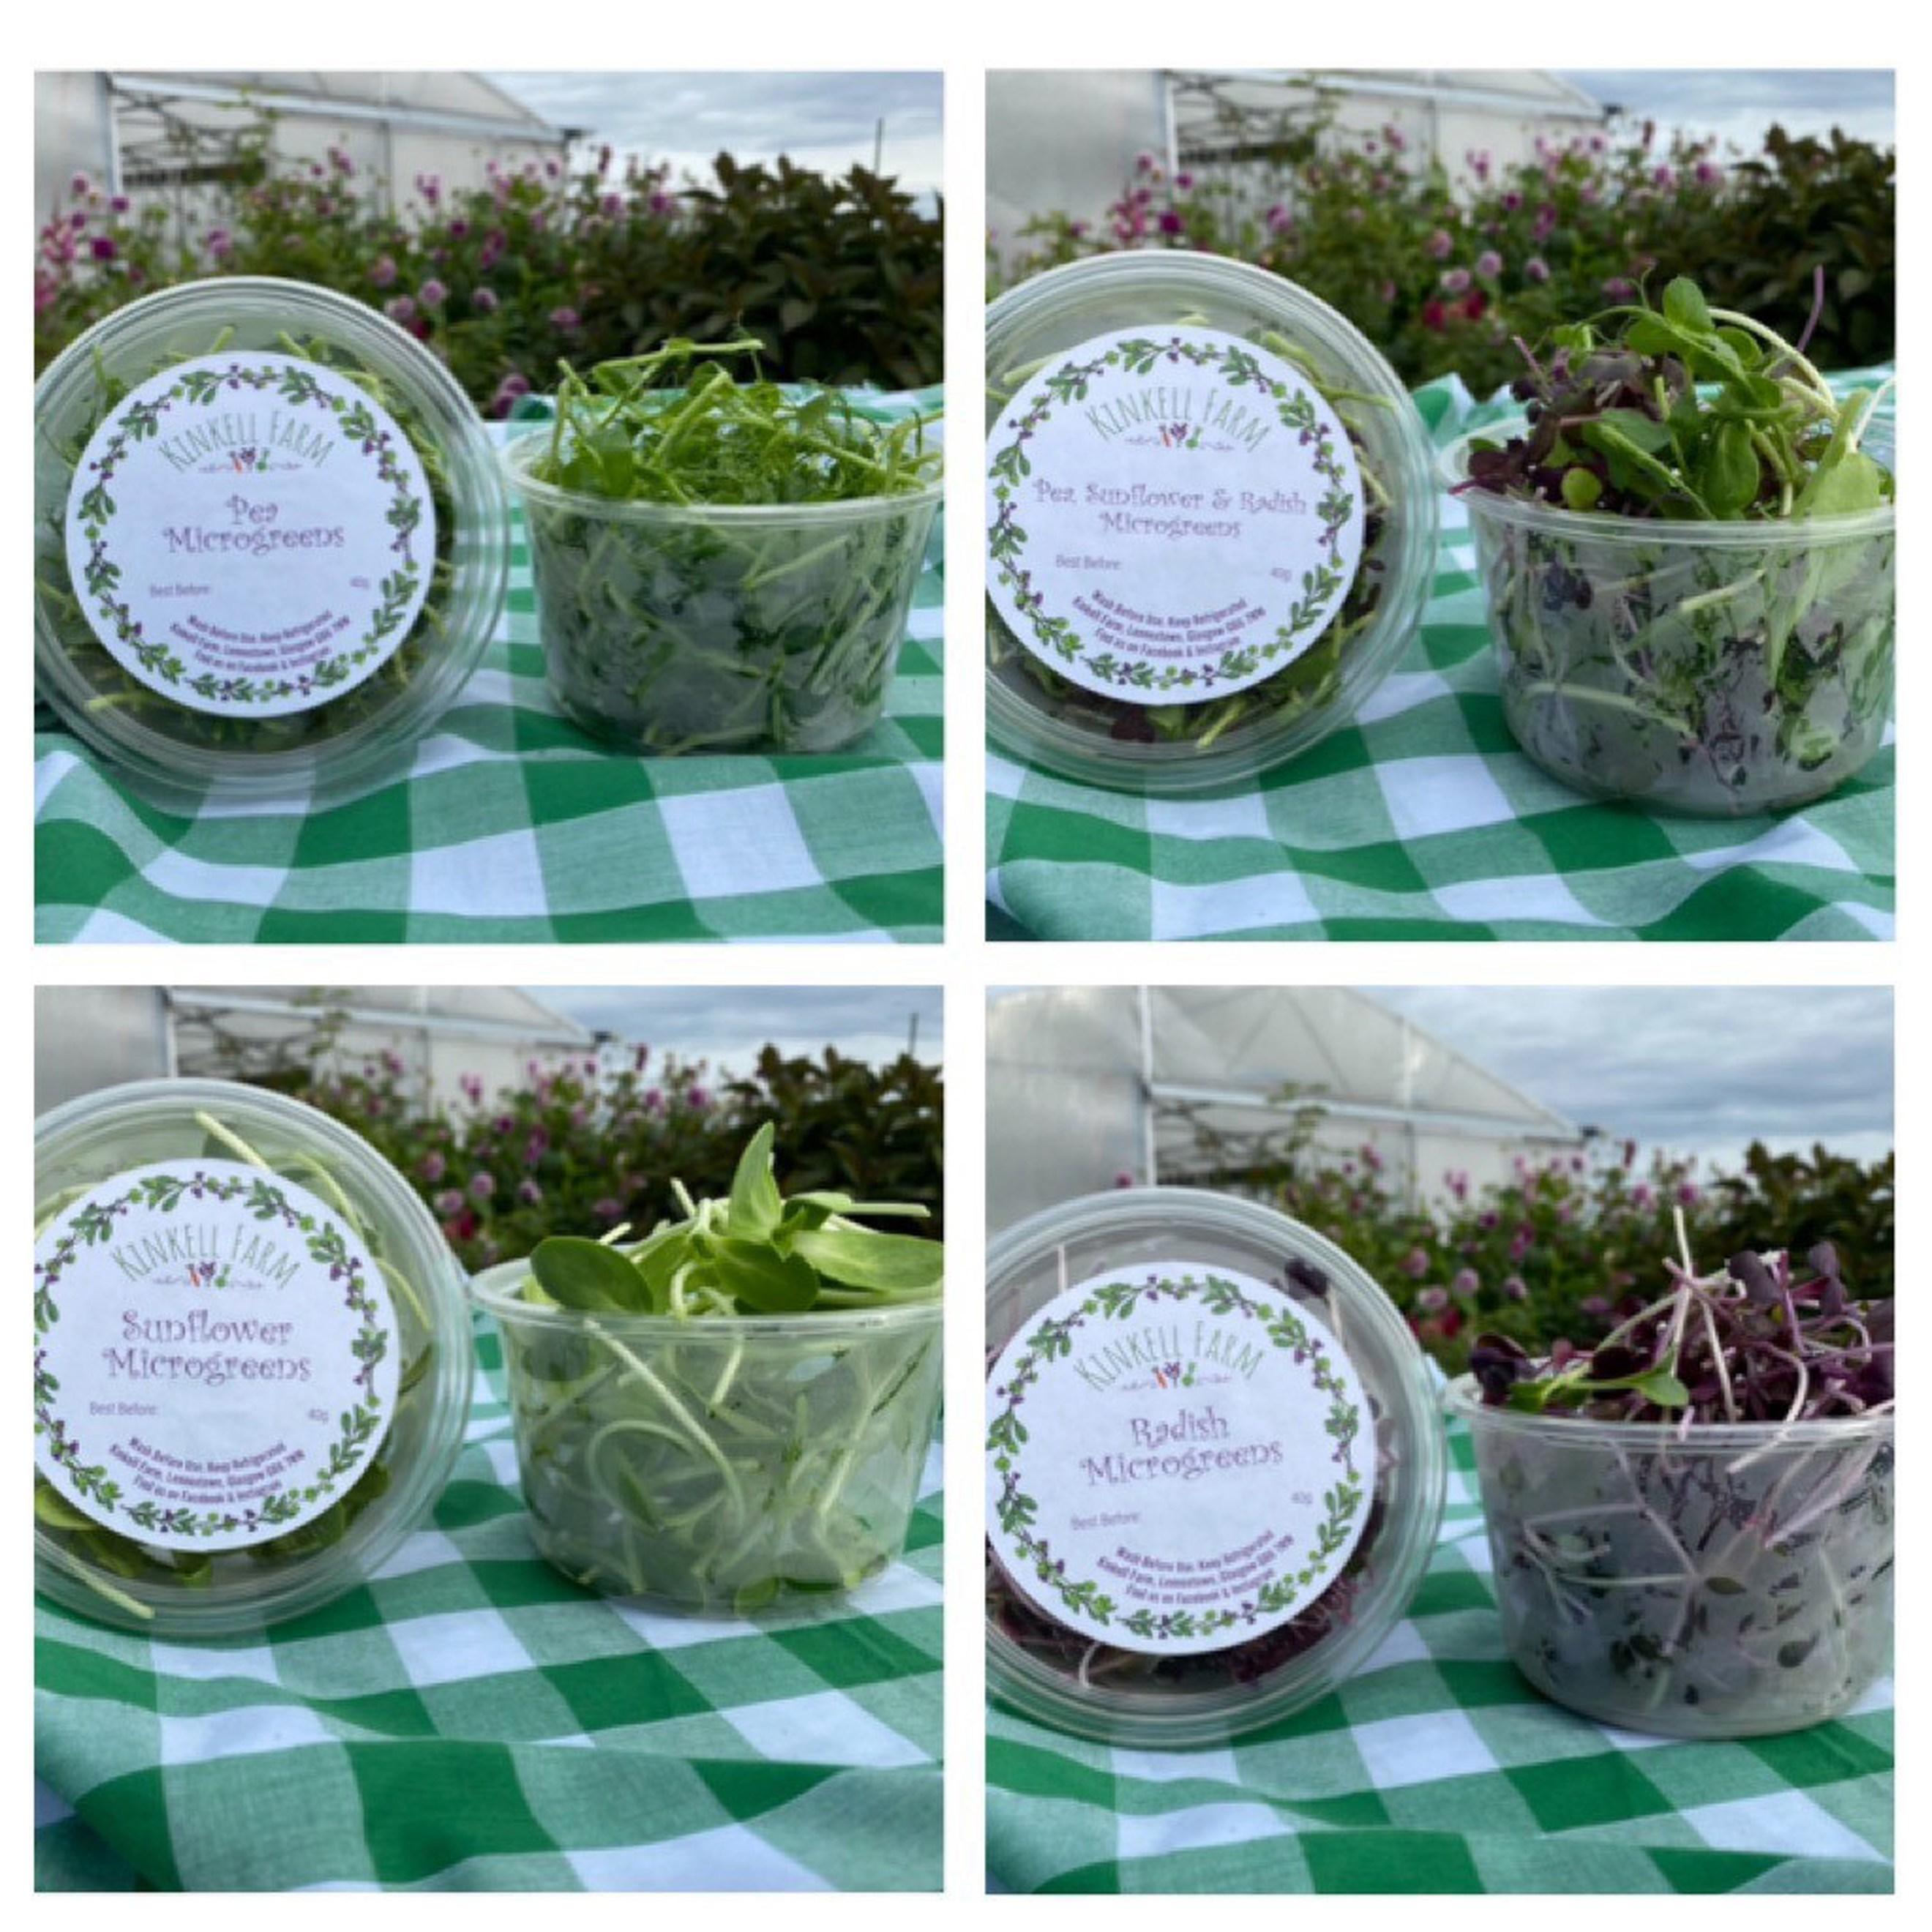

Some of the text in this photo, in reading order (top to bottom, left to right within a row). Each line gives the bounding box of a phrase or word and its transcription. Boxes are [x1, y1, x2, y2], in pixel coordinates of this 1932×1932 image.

[1085, 386, 1270, 452] KINKELL FARM
[158, 410, 334, 472] KINKELL FARM
[225, 494, 278, 525] Pea
[1085, 483, 1204, 510] Sunflower
[1240, 490, 1306, 512] Radish
[162, 526, 345, 555] Microgreens
[1100, 511, 1242, 538] Microgreens
[1056, 554, 1080, 569] Best
[150, 583, 173, 597] Best
[112, 1223, 300, 1289] KINKELL FARM
[122, 1308, 293, 1344] Sunflower
[102, 1347, 312, 1386] Microgreens
[1073, 1321, 1265, 1391] KINKELL FARM
[90, 1401, 114, 1415] Best
[1131, 1405, 1229, 1449] Radish
[1079, 1441, 1282, 1486] Microgreens
[1070, 1514, 1098, 1530] Best
